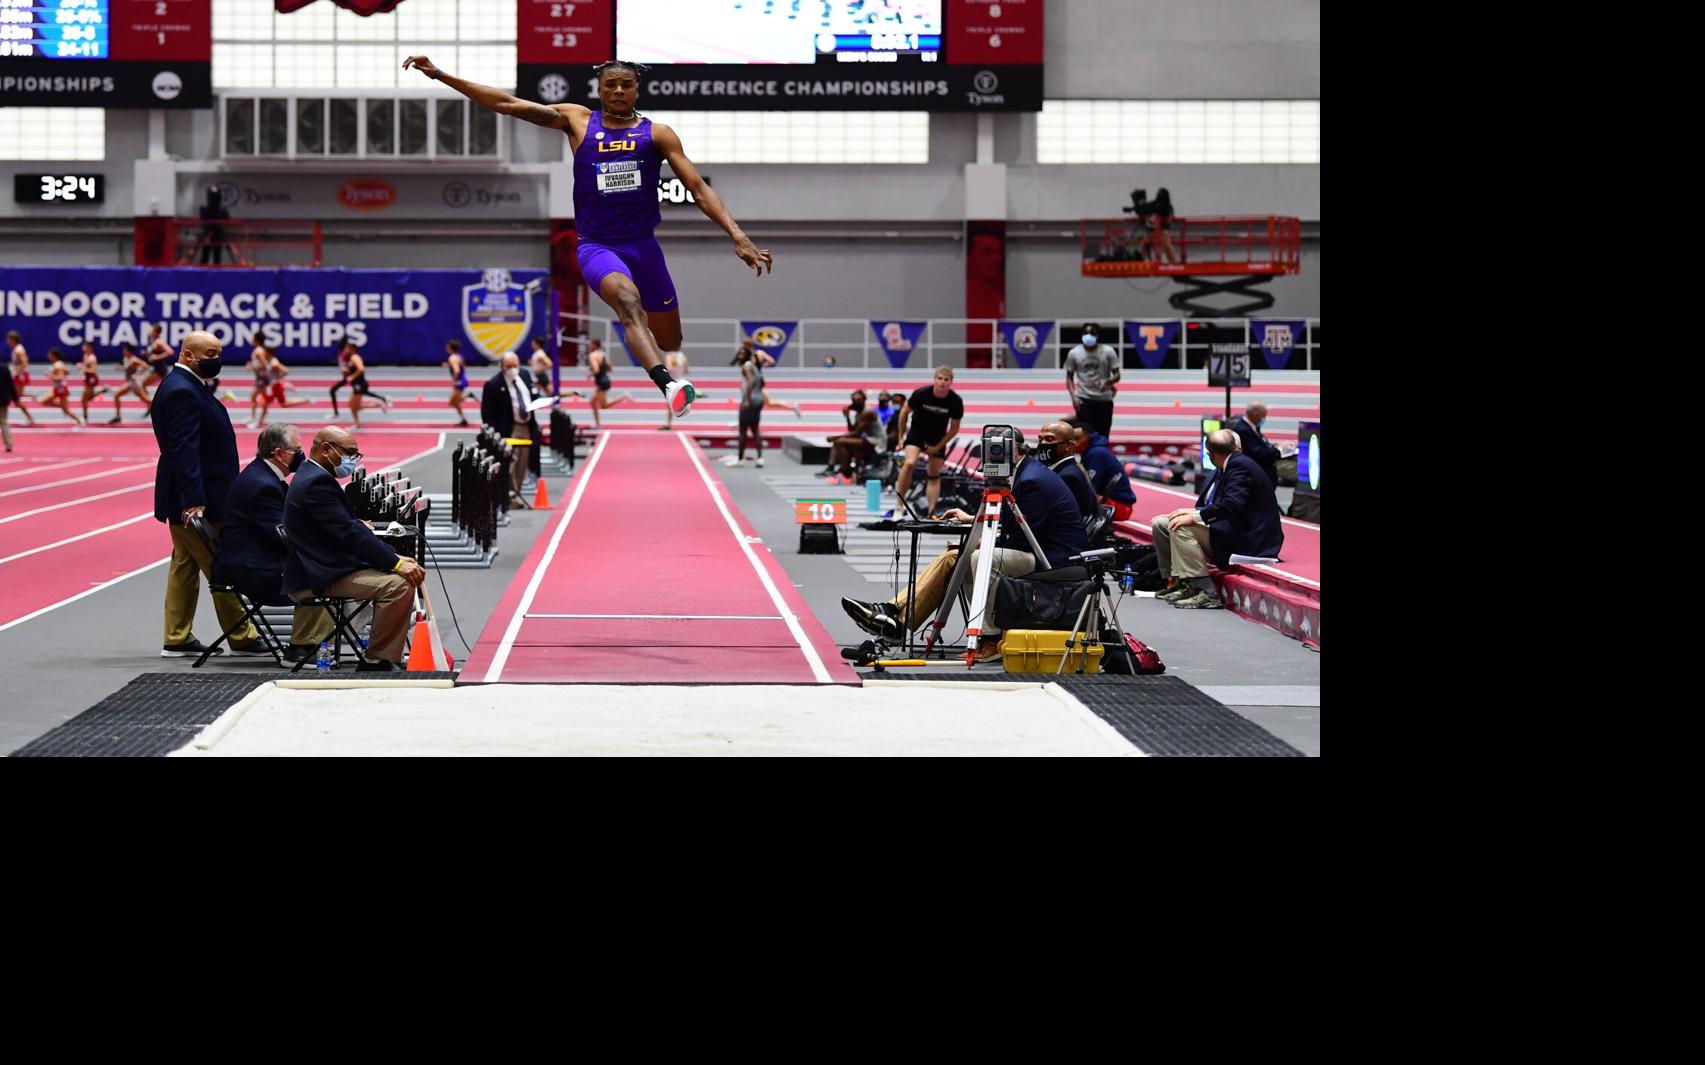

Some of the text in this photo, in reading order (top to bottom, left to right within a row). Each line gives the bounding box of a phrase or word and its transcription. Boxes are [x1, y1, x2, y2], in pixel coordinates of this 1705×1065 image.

[155, 1, 167, 15] 2
[550, 4, 575, 17] 27
[157, 32, 165, 45] 1
[552, 33, 577, 47] 23
[989, 34, 1001, 47] 6
[0, 76, 115, 92] PIONSHIPS
[648, 80, 777, 95] CONFERENCE
[784, 80, 949, 95] CHAMPIONSHIPS
[598, 140, 636, 153] LSU
[41, 176, 95, 200] 3:24
[244, 188, 290, 203] Tyson
[345, 186, 389, 203] Tyson
[475, 188, 521, 205] Tyson
[0, 291, 429, 319] INDOOR TRACK & FIELD
[1139, 325, 1165, 351] T
[808, 503, 834, 520] 10
